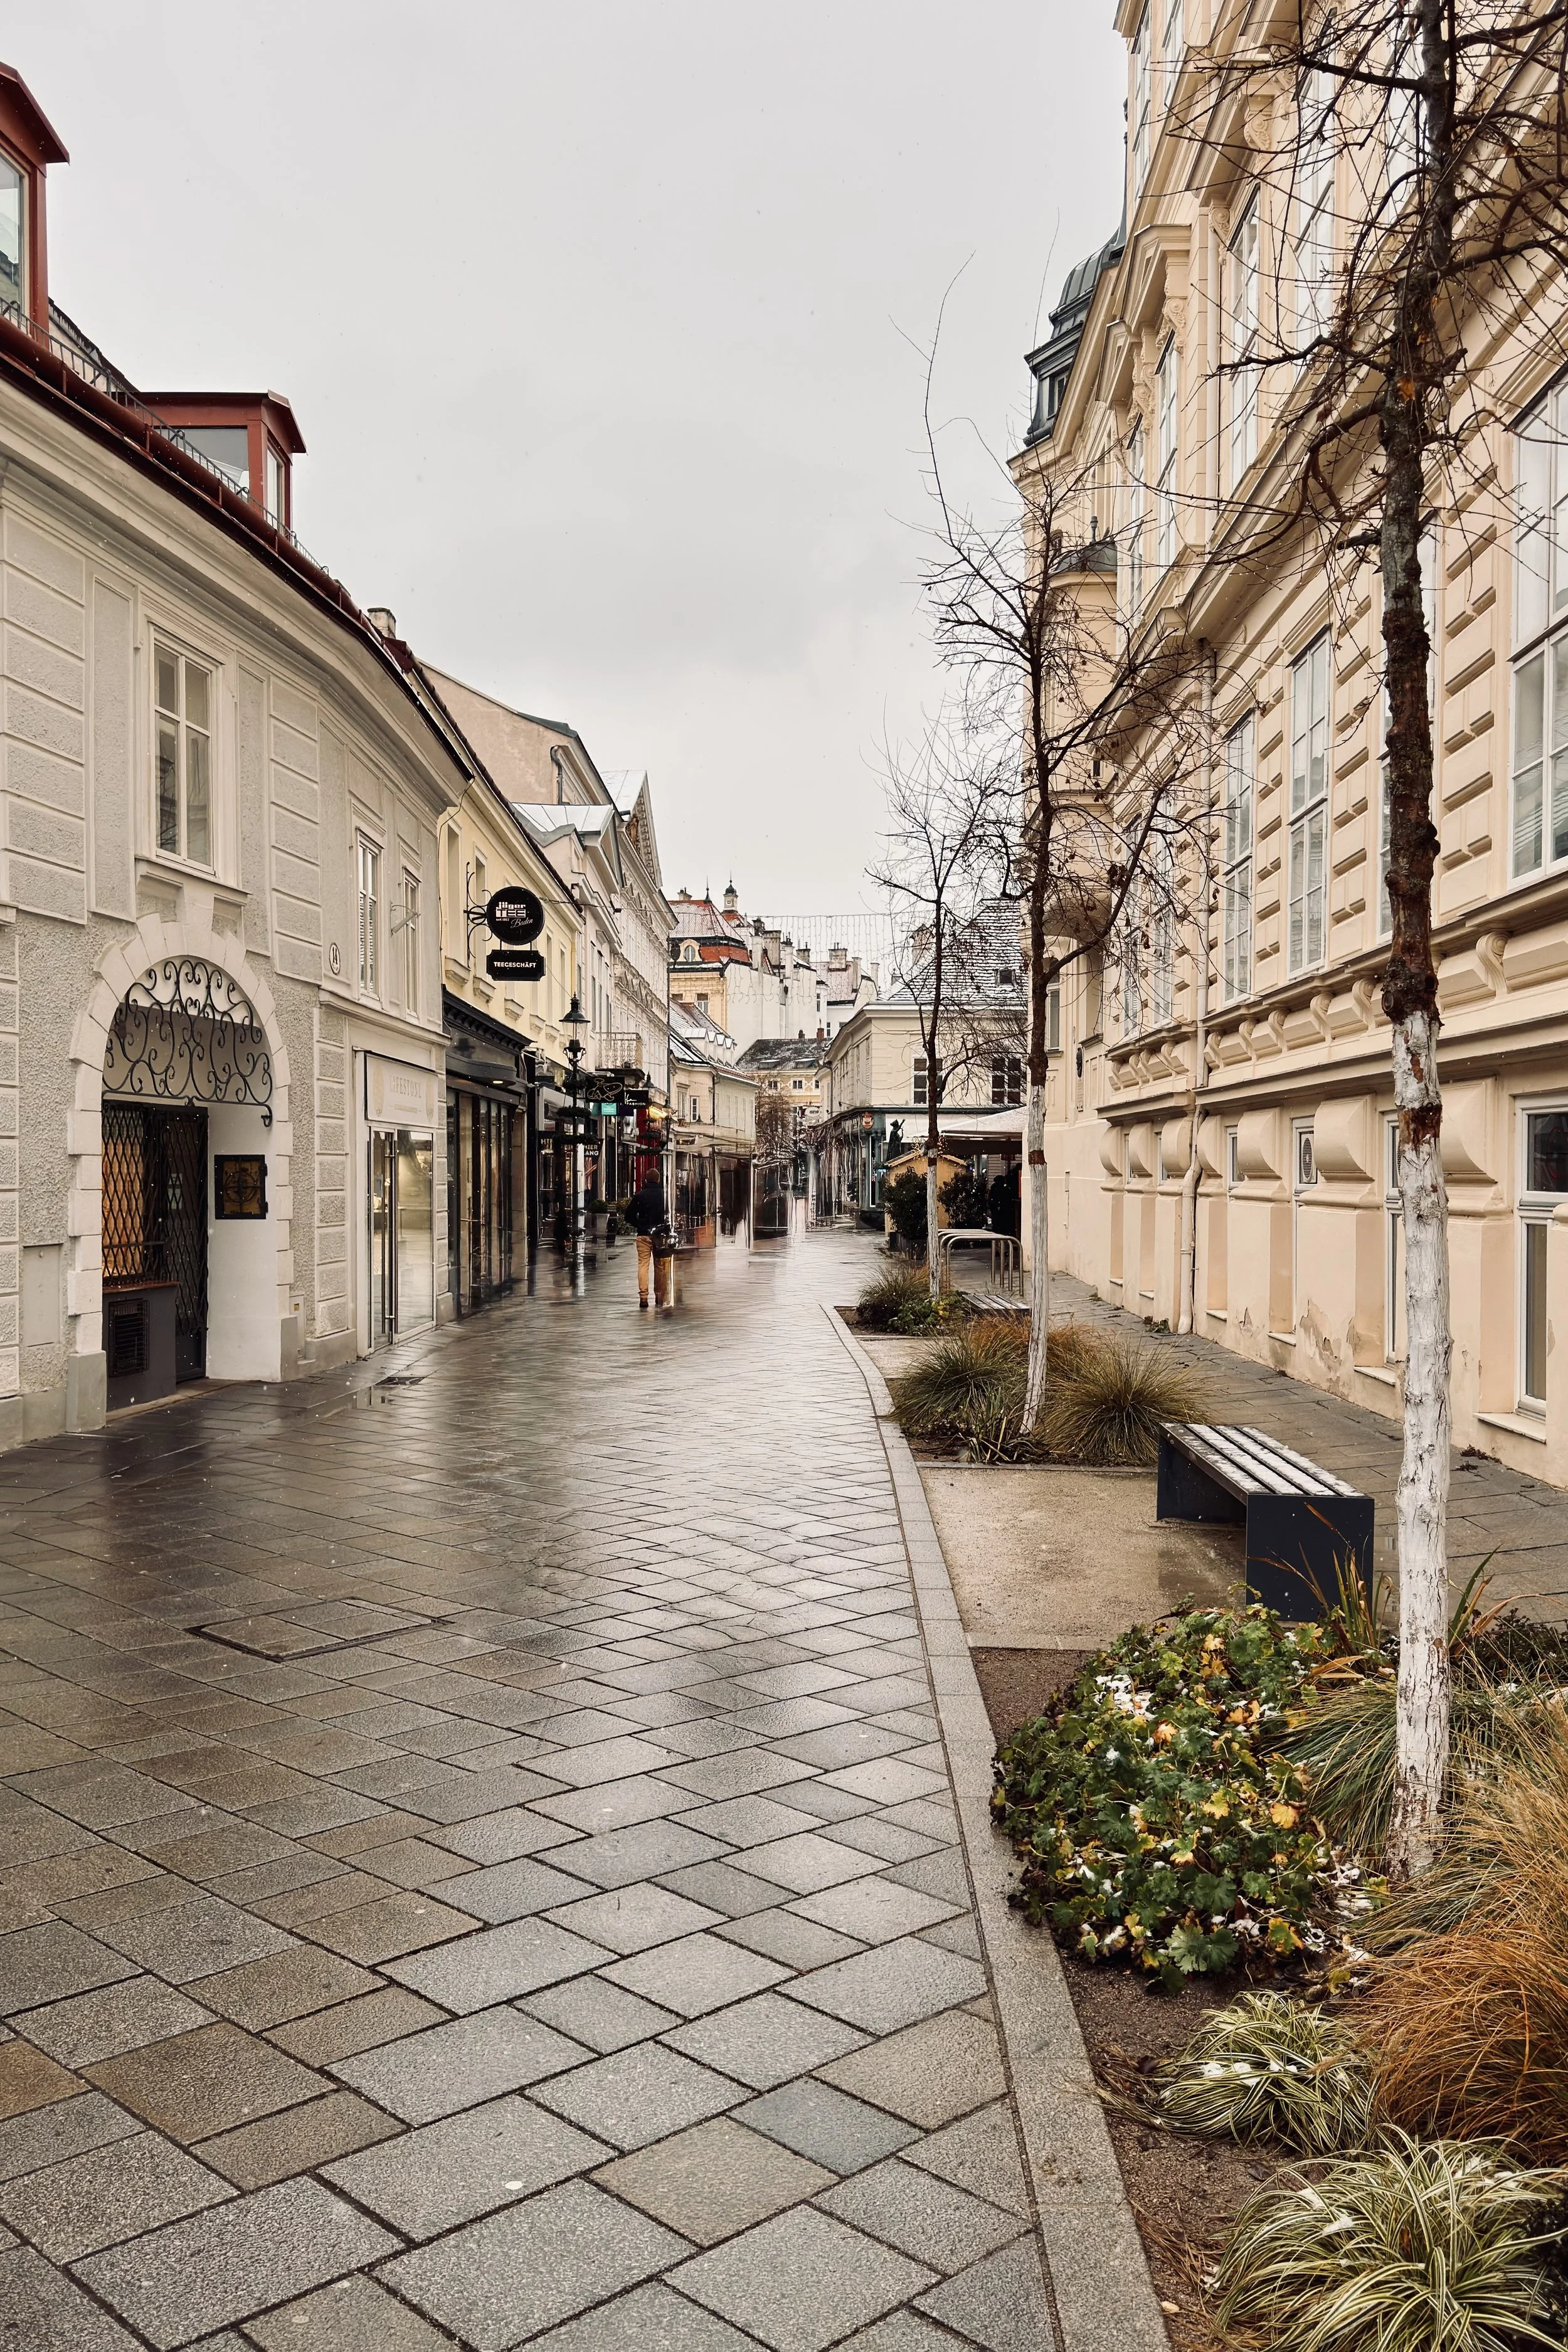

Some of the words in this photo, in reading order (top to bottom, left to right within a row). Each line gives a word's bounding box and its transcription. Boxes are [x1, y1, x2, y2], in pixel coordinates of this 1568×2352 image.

[496, 909, 526, 918] TEE
[510, 917, 533, 928] Baden
[332, 946, 338, 965] 14
